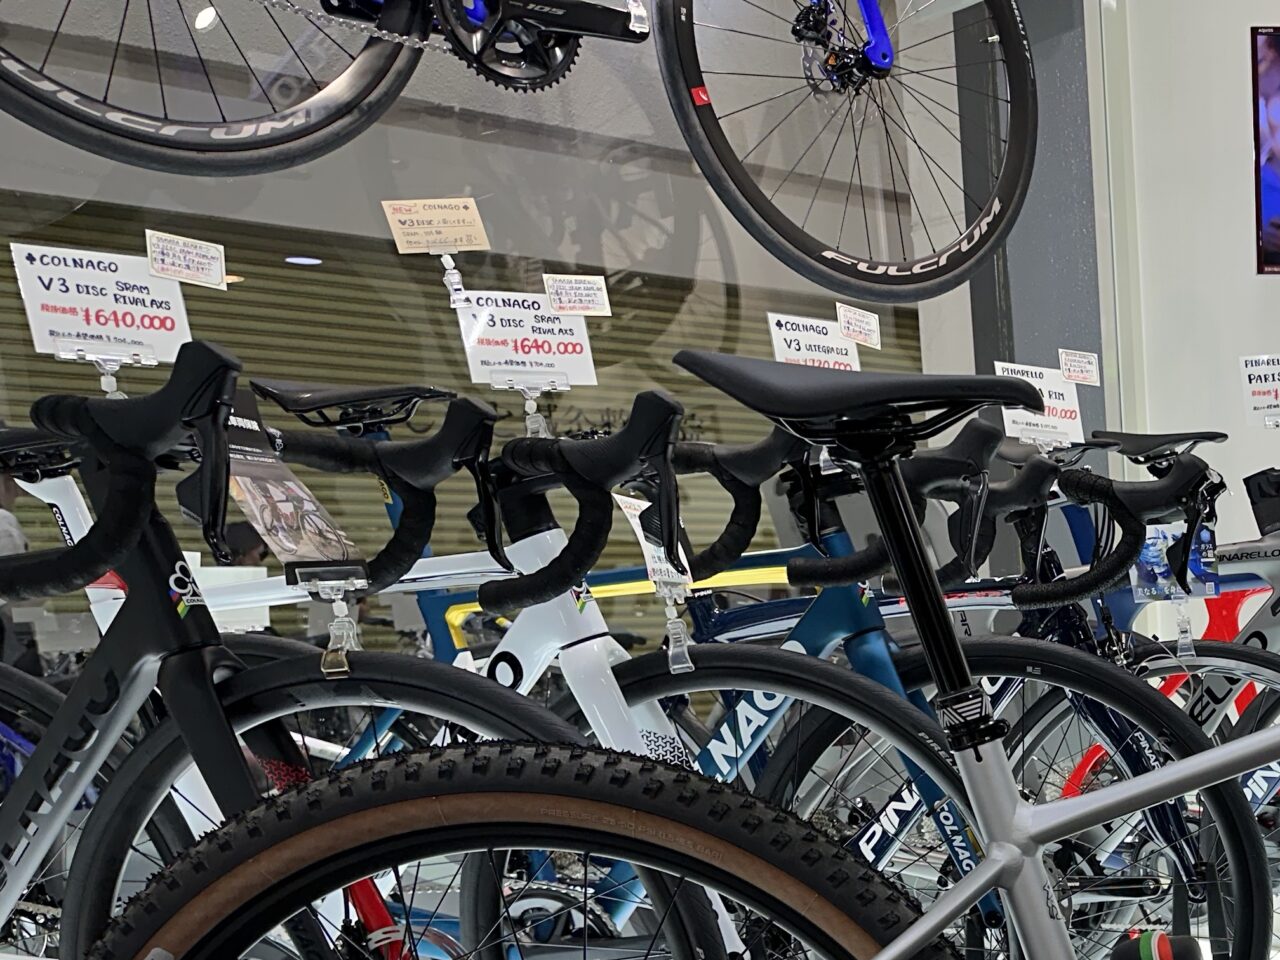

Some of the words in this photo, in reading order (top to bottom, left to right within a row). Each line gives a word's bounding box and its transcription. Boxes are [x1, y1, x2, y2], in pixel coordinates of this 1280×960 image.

[526, 3, 567, 15] 105
[0, 54, 311, 140] ULCRUM
[821, 197, 1002, 275] FULCRUM
[40, 254, 119, 273] COLNAGO
[37, 275, 69, 293] V3
[76, 283, 108, 297] DISC
[115, 280, 150, 295] SRAM
[114, 294, 149, 308] RIVAL
[150, 299, 171, 310] AXS
[476, 297, 541, 311] COLNAGO
[80, 307, 176, 332] ¥640,000
[500, 318, 525, 328] DISC
[534, 314, 561, 324] SRAM
[531, 326, 556, 335] RIVAL
[558, 328, 575, 336] AXS
[784, 321, 829, 336] COLNAGO
[784, 338, 802, 352] V3
[805, 344, 835, 355] ULTEGRA
[1002, 367, 1044, 379] PINARELLO
[1048, 390, 1065, 401] RIM
